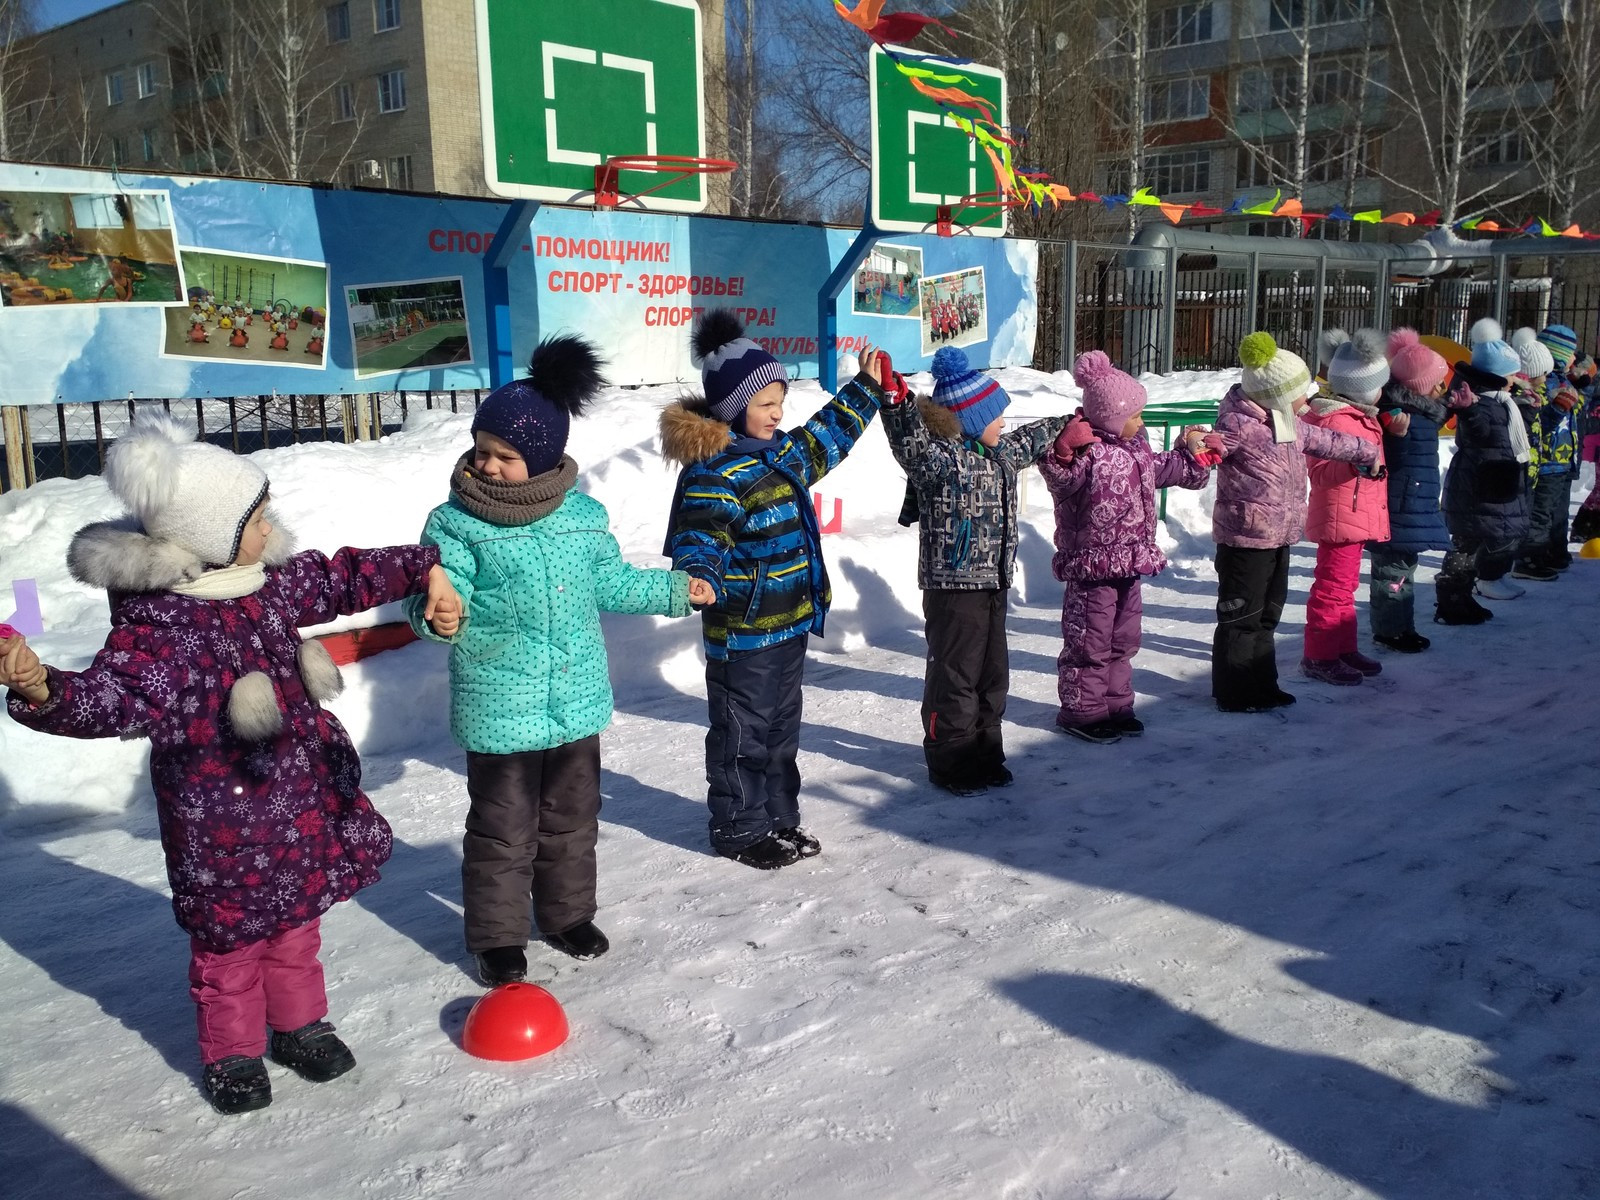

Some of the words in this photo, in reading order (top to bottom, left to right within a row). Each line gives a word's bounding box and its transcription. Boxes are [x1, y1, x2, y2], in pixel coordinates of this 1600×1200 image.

[536, 235, 670, 265] ПОМОЩНИК!
[548, 270, 623, 294] СПОРТ
[638, 273, 745, 298] ЗДОРОВЬЕ!
[733, 307, 777, 327] ГРА!
